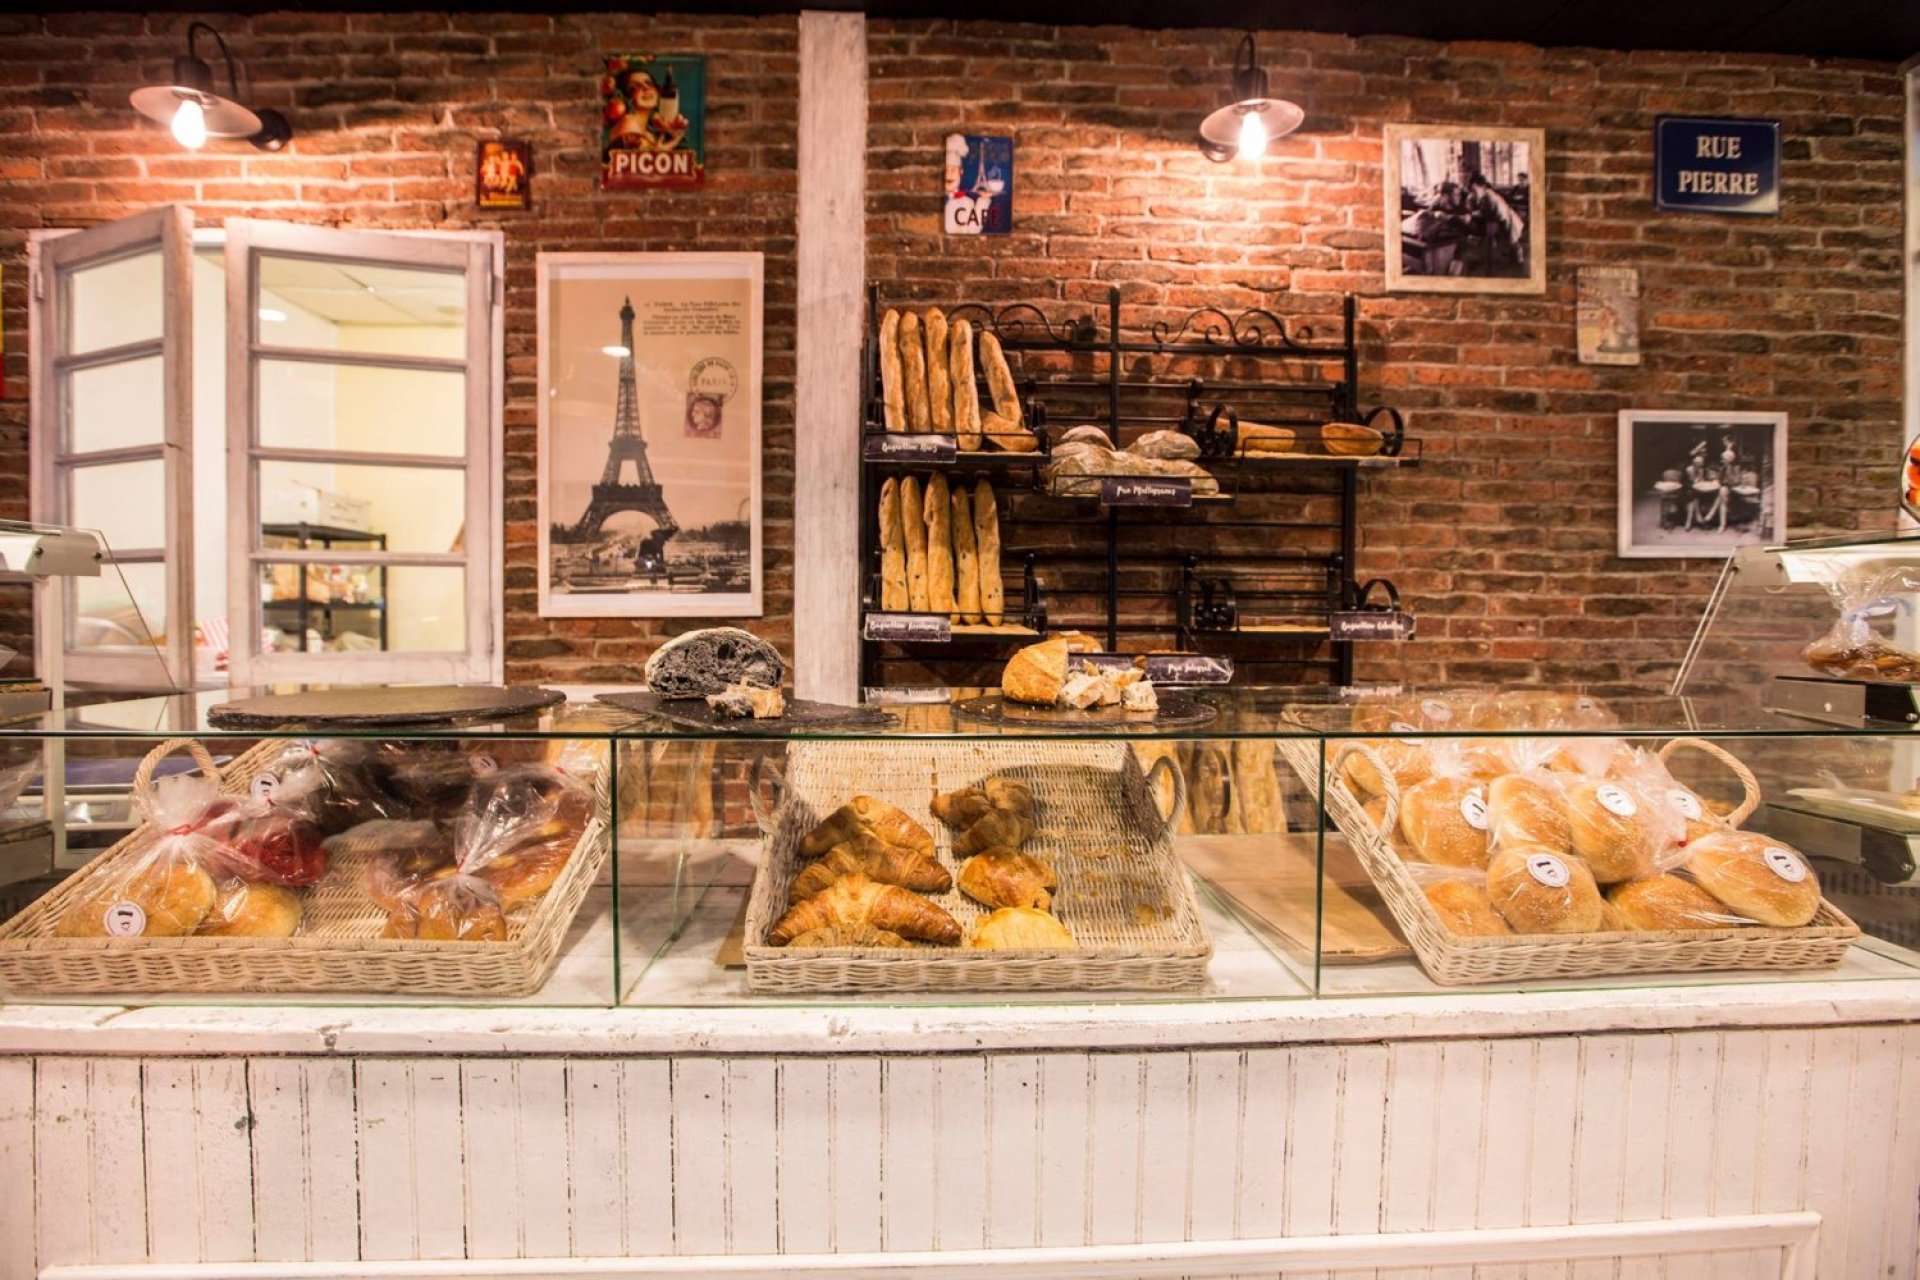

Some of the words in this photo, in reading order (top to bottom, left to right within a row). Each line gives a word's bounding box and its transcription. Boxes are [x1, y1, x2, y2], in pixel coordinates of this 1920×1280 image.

[1696, 135, 1742, 159] RUE
[616, 152, 687, 173] PICON
[1678, 170, 1759, 195] PIERRE
